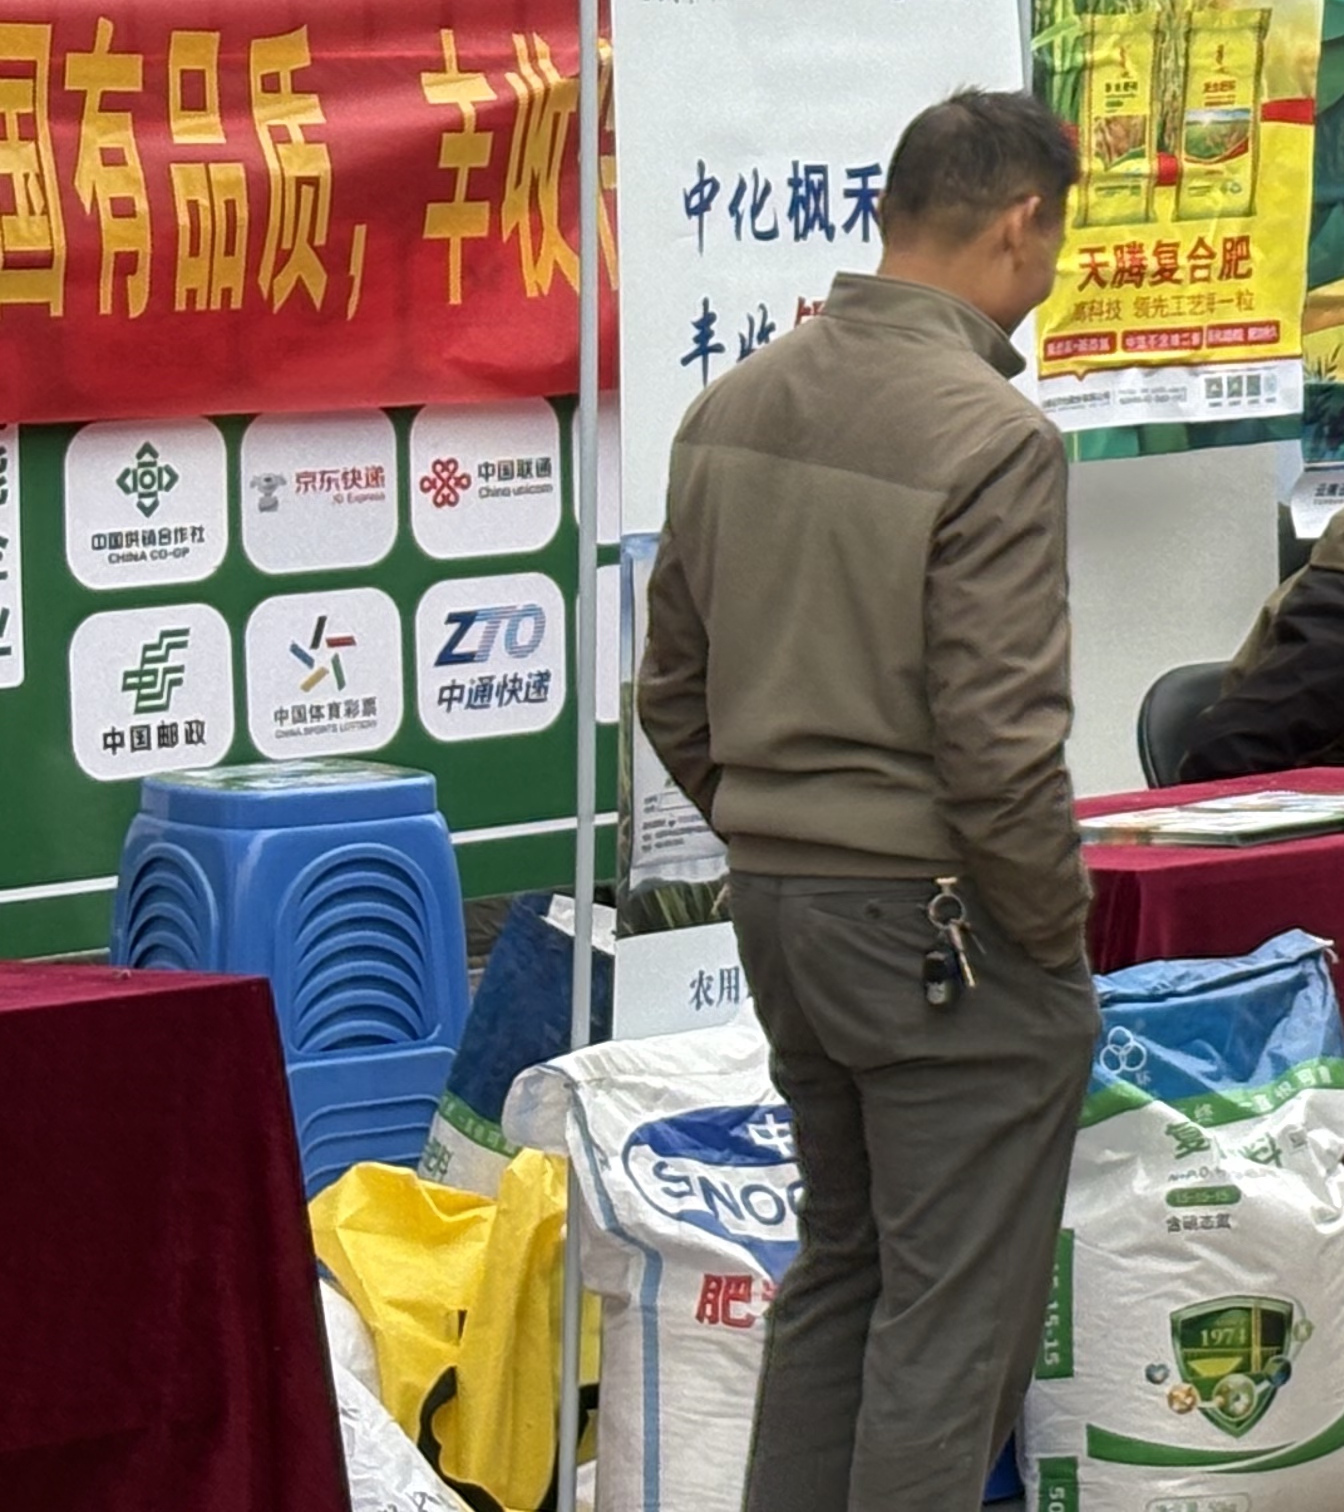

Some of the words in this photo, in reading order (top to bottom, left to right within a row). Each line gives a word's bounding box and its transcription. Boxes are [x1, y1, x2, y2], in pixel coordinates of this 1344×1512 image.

[1077, 235, 1253, 292] 天腾复合肥
[295, 466, 385, 494] 京东快递
[477, 457, 552, 481] 中国联通
[91, 524, 205, 551] 中国供销合作社
[434, 604, 547, 667] ZTO
[273, 697, 377, 727] 中国体育彩票
[437, 670, 552, 714] 中通快递
[102, 719, 207, 755] 中国邮政
[689, 965, 753, 1011] 农用
[695, 1273, 781, 1329] 肥
